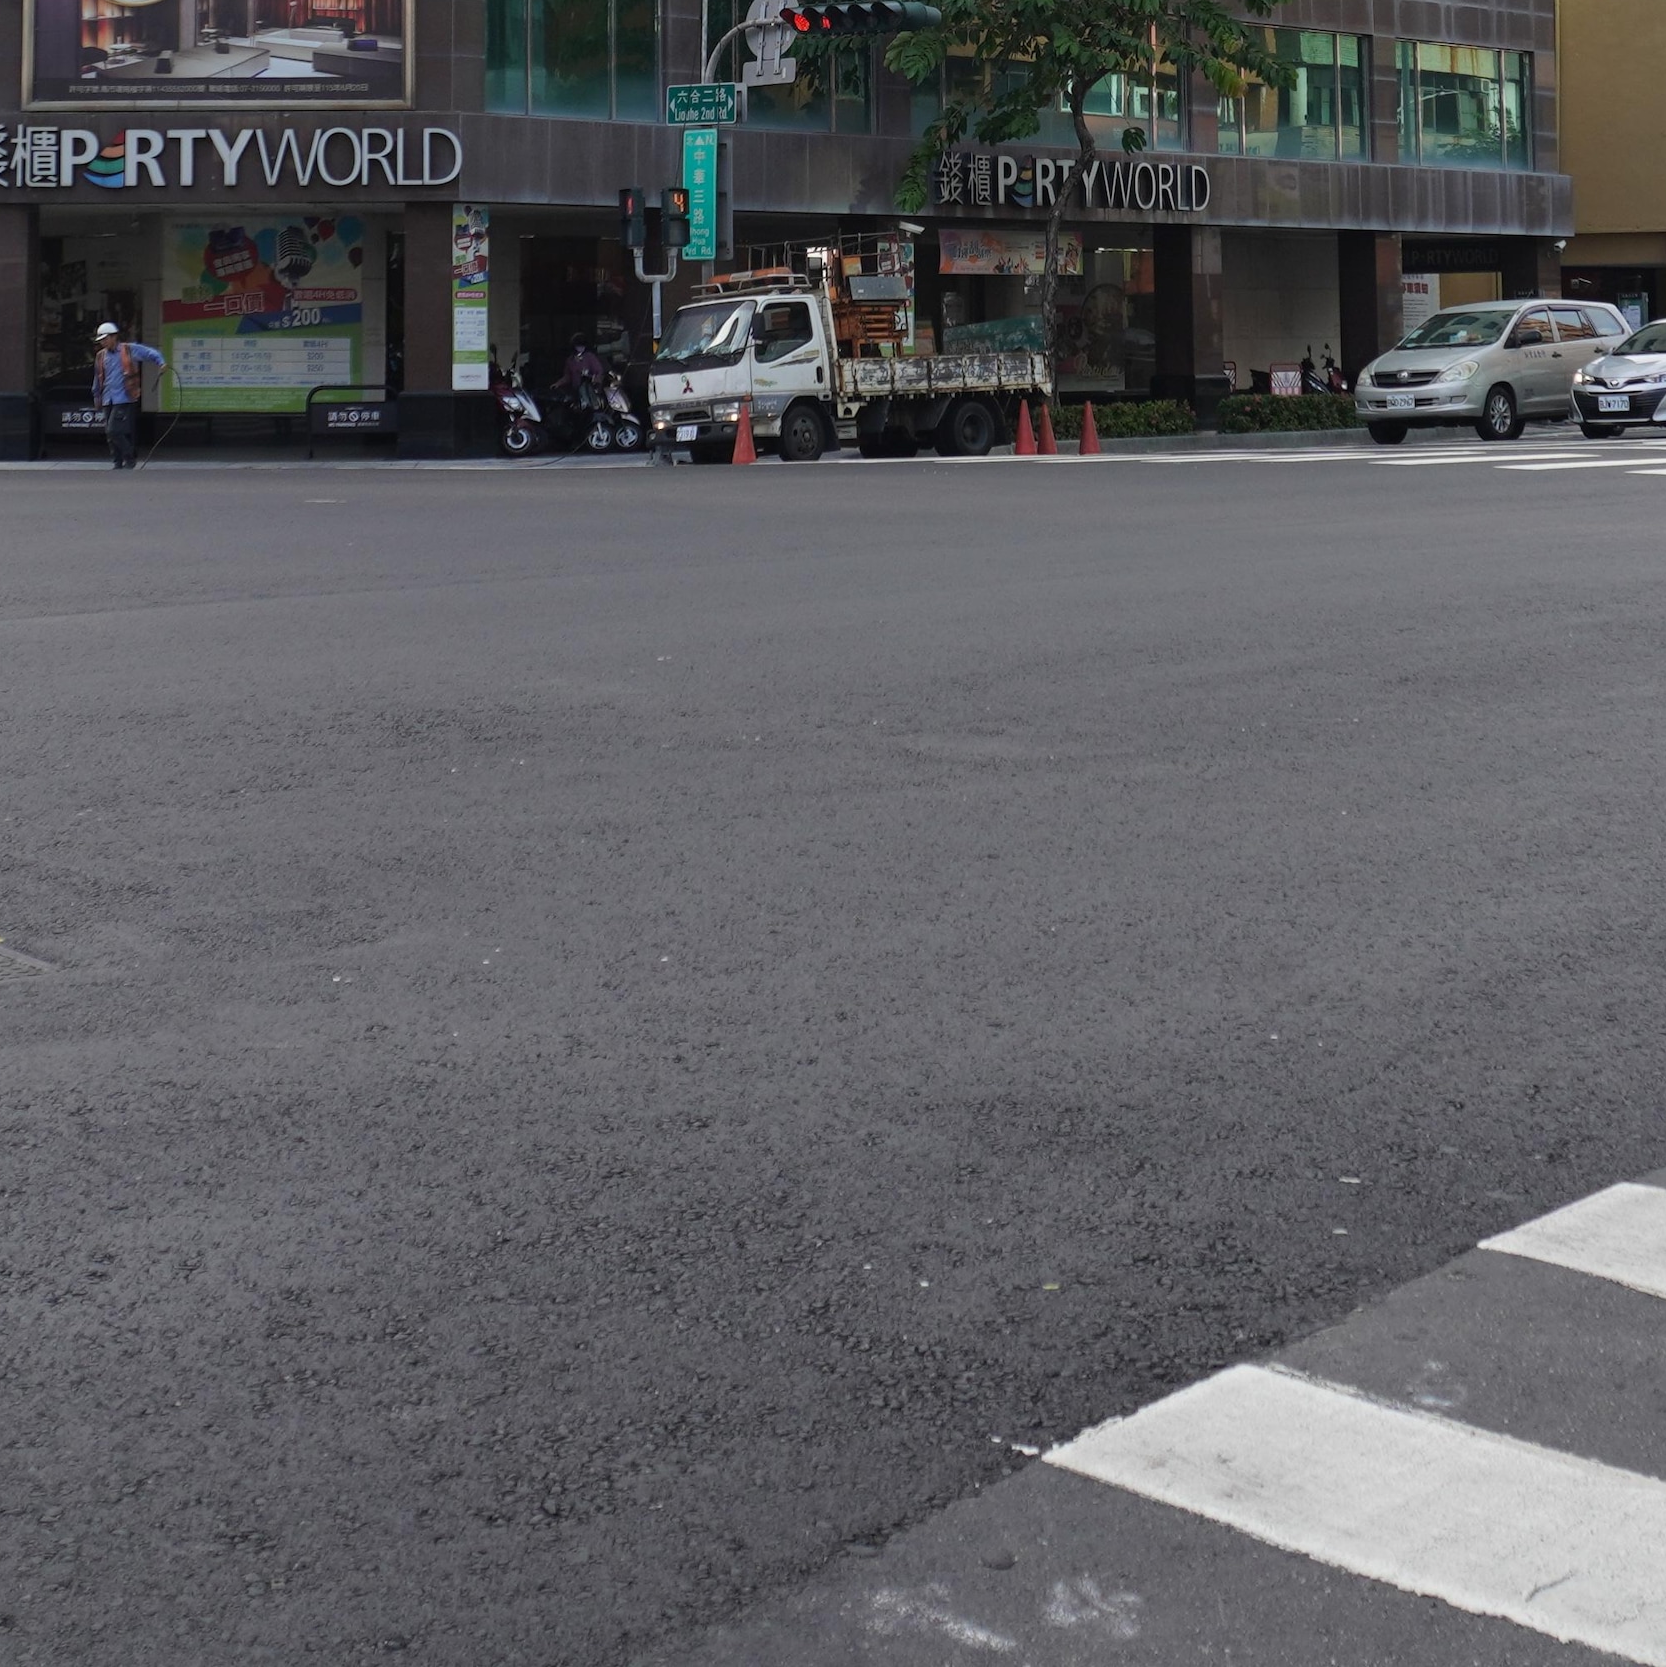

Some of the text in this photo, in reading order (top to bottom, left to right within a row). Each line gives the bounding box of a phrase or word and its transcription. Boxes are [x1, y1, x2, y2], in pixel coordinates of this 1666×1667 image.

[677, 88, 727, 104] 六合二路
[701, 107, 715, 120] 2nd
[939, 151, 991, 205] 錢櫃
